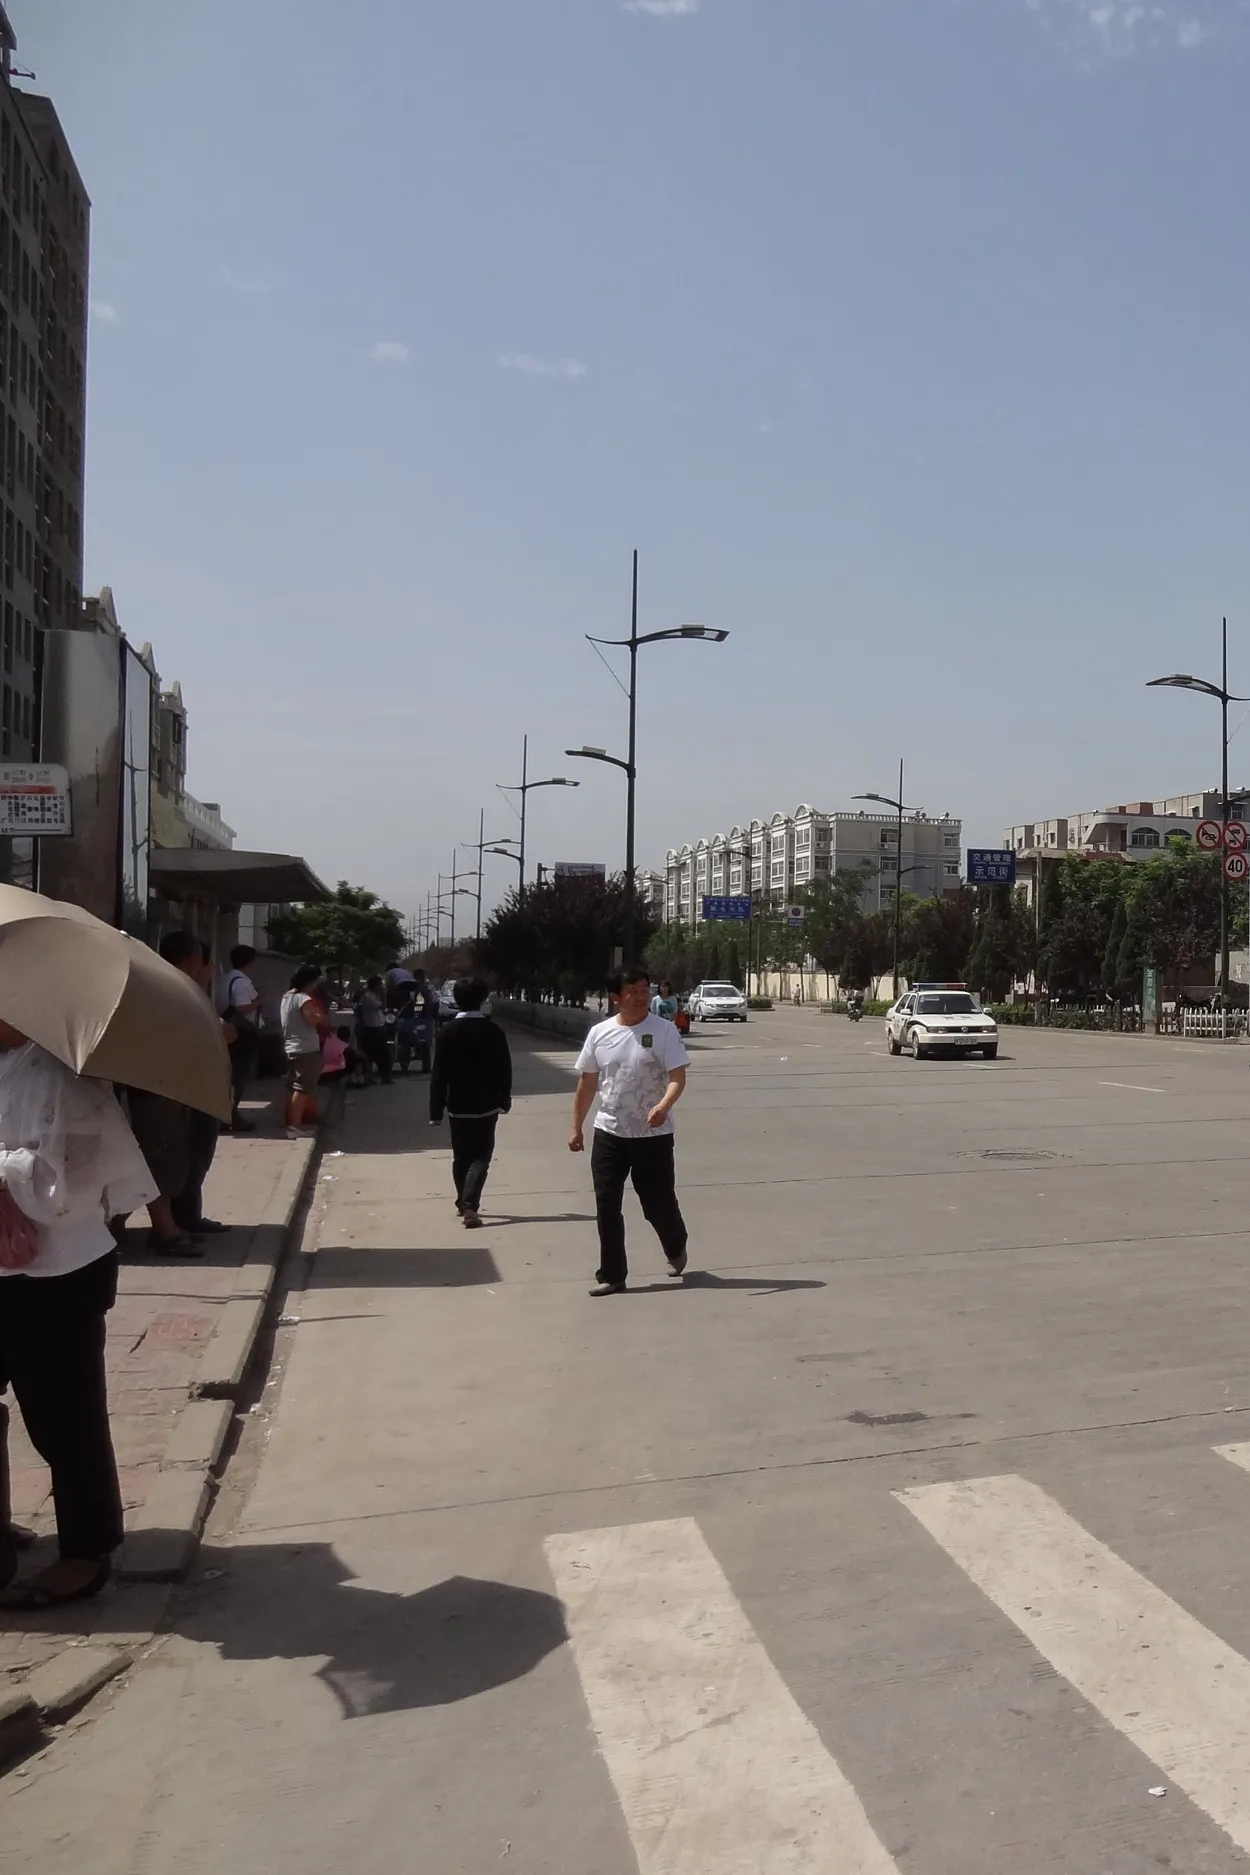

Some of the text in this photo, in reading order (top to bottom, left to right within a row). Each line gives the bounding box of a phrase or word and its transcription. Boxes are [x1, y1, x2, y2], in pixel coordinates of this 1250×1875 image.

[972, 853, 1011, 862] 交通管理
[975, 865, 1009, 879] 示范街
[1227, 859, 1243, 873] 40
